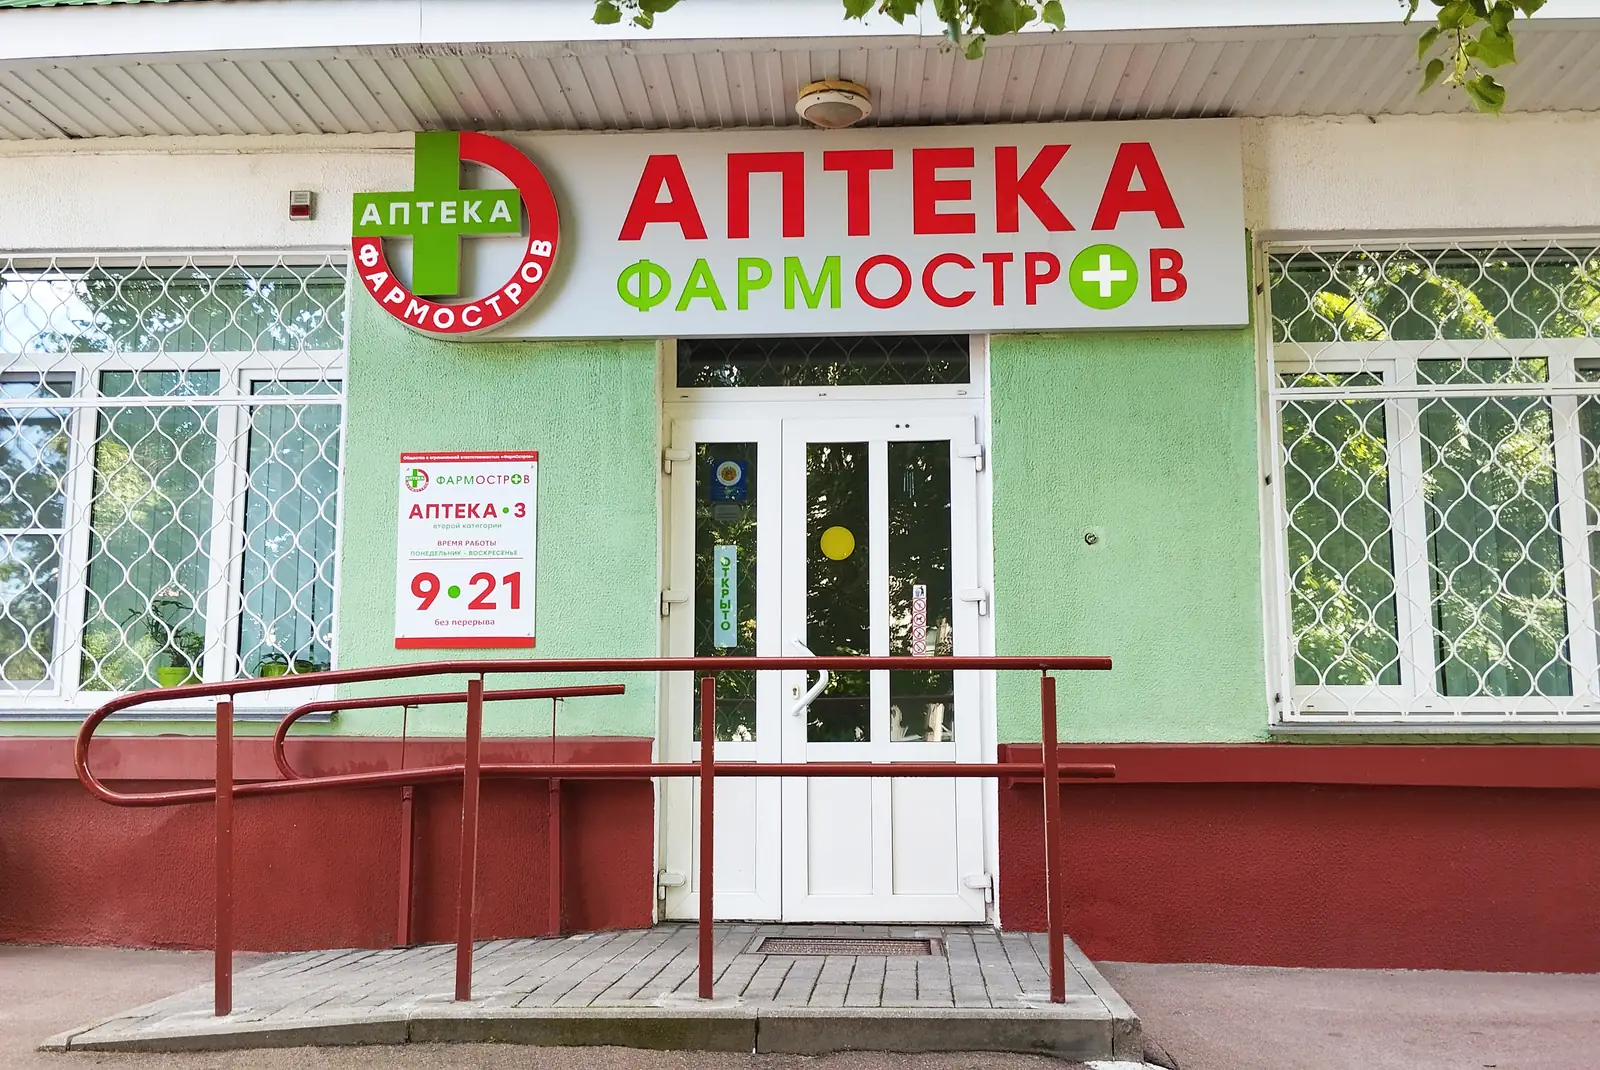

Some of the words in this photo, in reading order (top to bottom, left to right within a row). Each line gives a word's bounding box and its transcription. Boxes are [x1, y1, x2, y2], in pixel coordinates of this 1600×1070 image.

[617, 142, 1185, 241] АПТЕКА
[359, 200, 512, 226] АПТЕКА
[358, 239, 552, 329] ФАРМОСТРОВ
[408, 503, 498, 519] АПТЕКА
[514, 502, 527, 518] 3
[433, 522, 461, 530] второй
[462, 522, 502, 530] категории
[410, 571, 441, 611] 9
[467, 571, 521, 610] 21
[719, 556, 731, 631] ОТКРЫТО
[434, 618, 449, 626] без
[451, 619, 495, 627] перерыва
